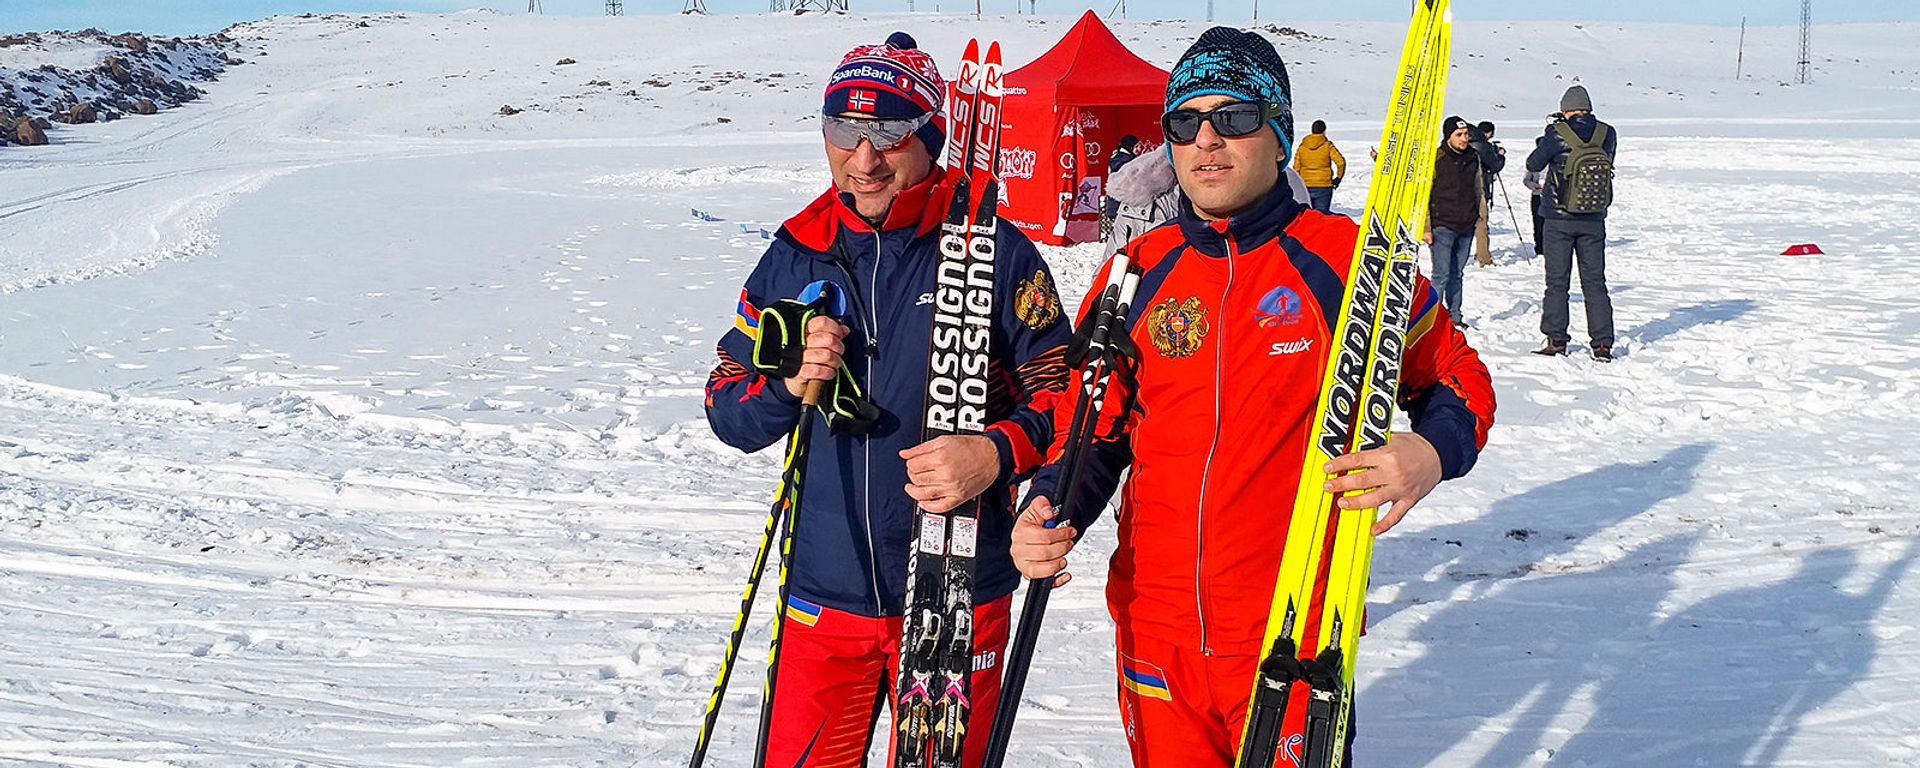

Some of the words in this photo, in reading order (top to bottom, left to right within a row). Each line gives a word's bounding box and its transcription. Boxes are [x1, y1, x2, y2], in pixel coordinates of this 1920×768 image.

[831, 65, 896, 84] SpareBank
[947, 97, 970, 170] WCS
[973, 101, 998, 172] WCS
[1382, 131, 1399, 176] BASE
[1392, 64, 1416, 128] TUNING
[926, 215, 969, 432] ROSSIGNOL
[957, 215, 998, 433] ROSSIGNOL
[1318, 206, 1392, 461] NORDWAY
[1357, 214, 1420, 454] NORDWAY
